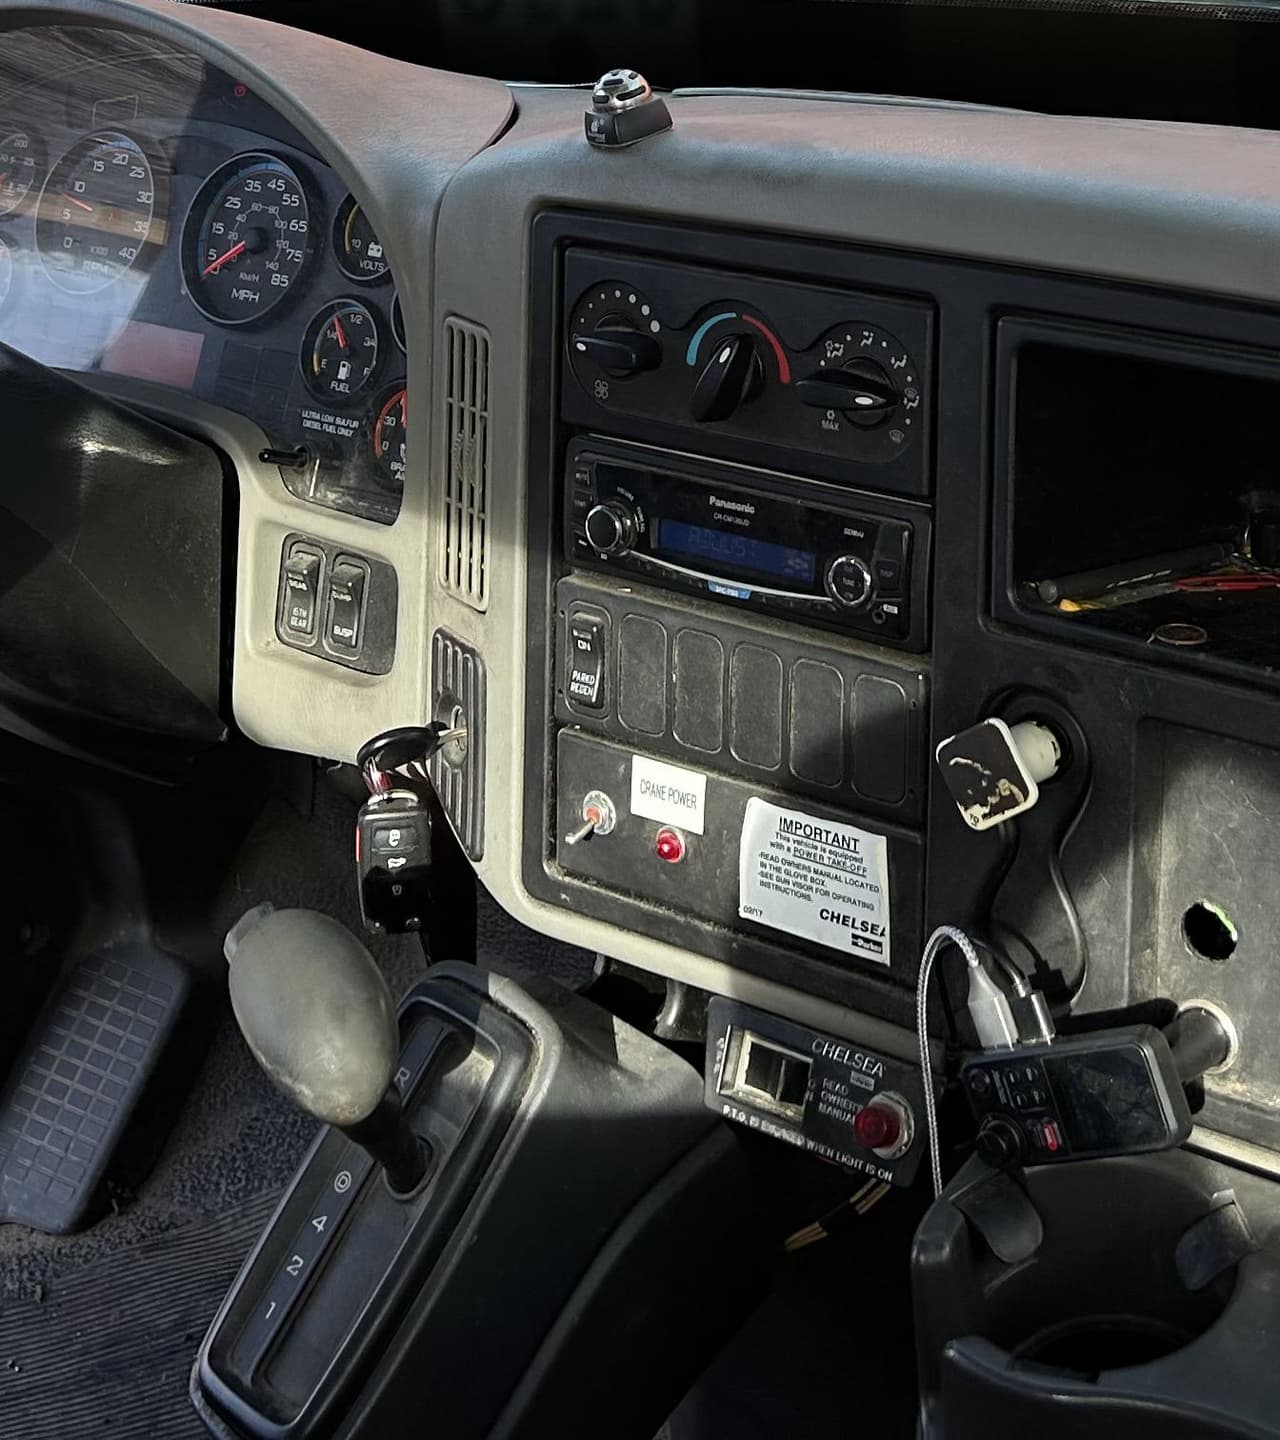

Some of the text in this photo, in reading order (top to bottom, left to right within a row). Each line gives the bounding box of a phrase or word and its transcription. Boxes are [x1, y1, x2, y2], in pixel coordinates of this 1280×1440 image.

[112, 153, 128, 165] 20
[93, 160, 105, 173] 15
[129, 166, 145, 179] 25
[74, 181, 86, 192] 10
[244, 180, 262, 192] 35
[267, 179, 286, 191] 45
[137, 191, 152, 204] 30
[224, 197, 241, 209] 25
[281, 194, 300, 207] 55
[63, 208, 71, 220] 5
[236, 214, 247, 222] 40
[134, 221, 149, 233] 35
[212, 222, 224, 234] 15
[274, 220, 287, 229] 100
[289, 219, 307, 232] 65
[227, 232, 238, 241] 20
[352, 239, 361, 249] 10
[119, 247, 137, 260] 40
[208, 248, 217, 260] 5
[286, 249, 303, 262] 75
[265, 261, 279, 271] 140
[360, 260, 384, 272] VOLTS
[271, 274, 289, 287] 85
[231, 288, 260, 303] MPH
[350, 314, 363, 325] 1/2
[321, 359, 328, 369] E
[330, 381, 351, 394] FUEL
[302, 410, 360, 428] ULTRA LOW SULFUR
[384, 416, 396, 426] 30
[303, 419, 354, 437] DIESEL FUEL ONLY
[382, 441, 389, 451] 0
[709, 495, 756, 515] Panasonic
[639, 779, 697, 809] CRANE POWER
[779, 817, 860, 852] IMPORTANT
[776, 831, 790, 843] This
[792, 837, 818, 850] vehicle
[828, 847, 864, 863] equipped
[793, 846, 825, 862] POWER
[827, 856, 867, 875] TAKE-OFF
[769, 863, 783, 874] THE
[783, 869, 808, 882] GLOVE
[813, 867, 843, 883] MANUAL
[844, 876, 880, 893] LOCATED
[776, 875, 790, 886] SUN
[791, 880, 814, 893] VISOR
[815, 886, 831, 898] FOR
[831, 892, 875, 911] OPERATING
[812, 1039, 884, 1078] CHELSEA
[394, 1066, 410, 1089] R
[822, 1077, 849, 1096] READ
[805, 1135, 834, 1158] WHEN
[836, 1148, 864, 1170] LIGHT
[865, 1162, 876, 1176] IS
[878, 1167, 893, 1182] ON
[311, 1215, 328, 1233] 4
[286, 1253, 304, 1277] 2
[265, 1302, 276, 1320] 1
